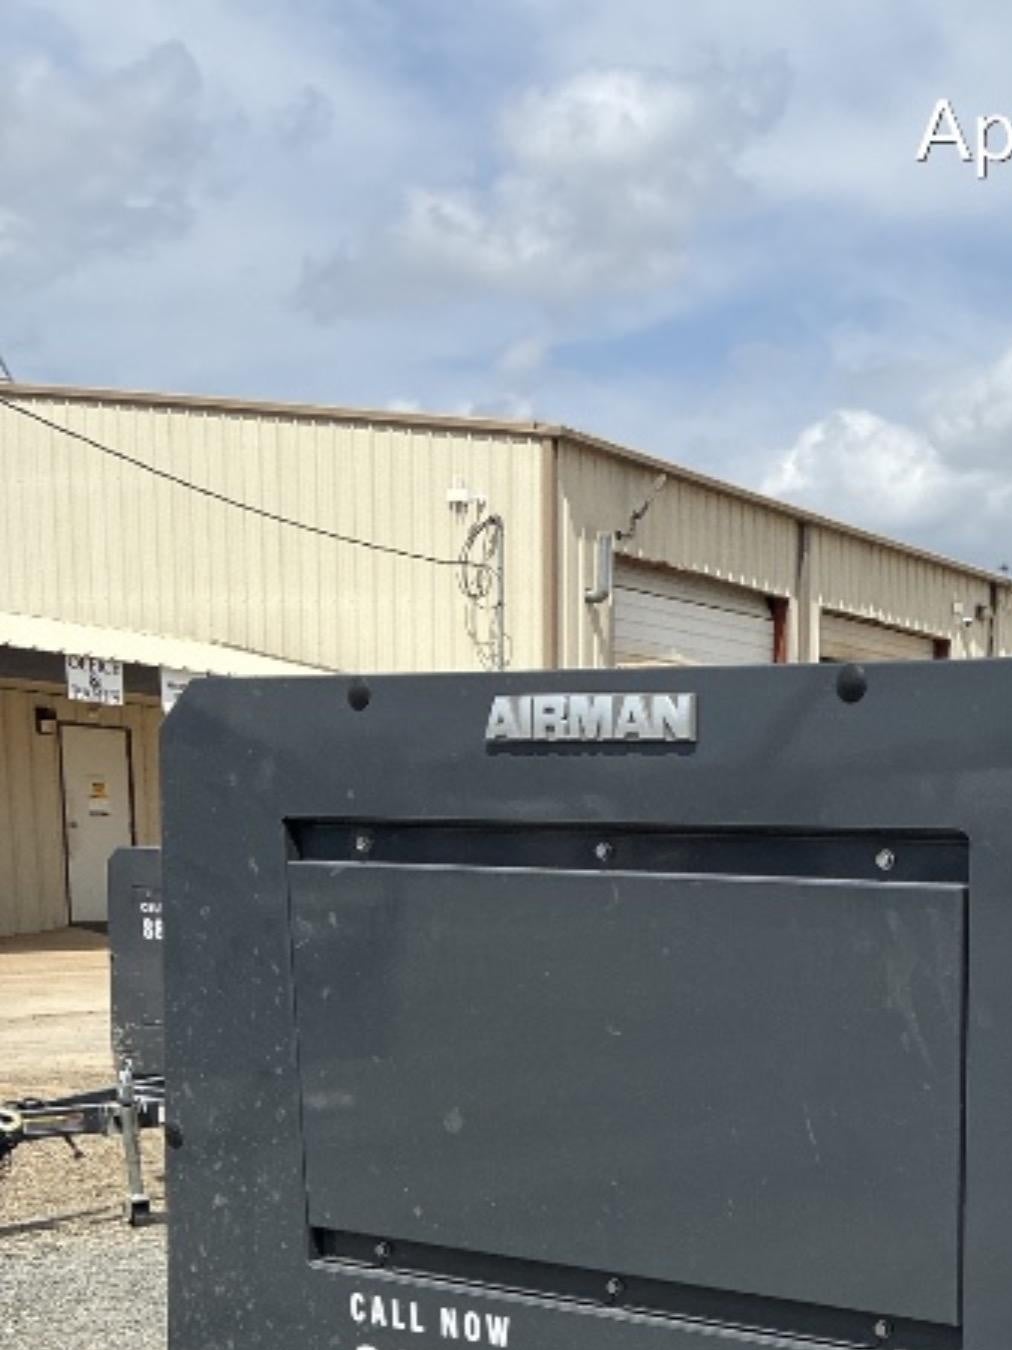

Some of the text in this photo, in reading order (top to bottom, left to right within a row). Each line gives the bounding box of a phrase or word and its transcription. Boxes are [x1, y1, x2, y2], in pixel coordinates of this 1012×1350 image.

[485, 693, 697, 741] AIRMAN
[350, 1291, 511, 1348] CALL NOW
